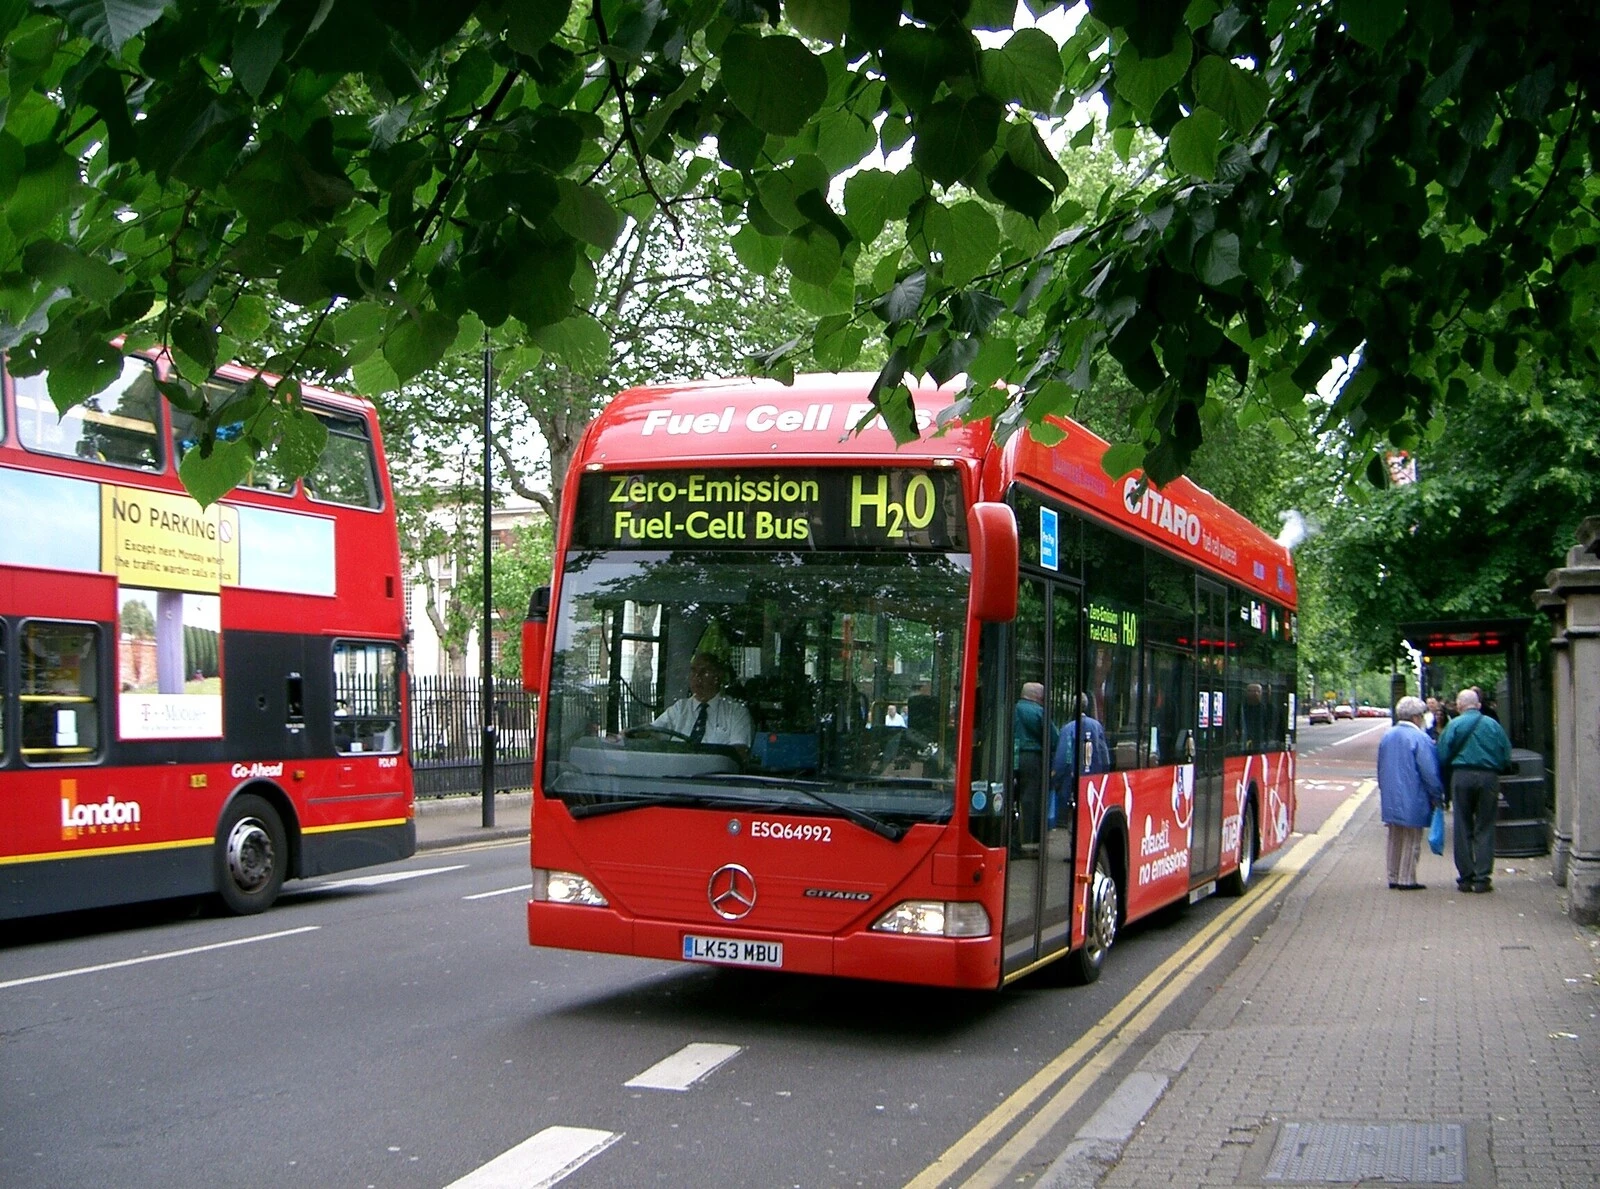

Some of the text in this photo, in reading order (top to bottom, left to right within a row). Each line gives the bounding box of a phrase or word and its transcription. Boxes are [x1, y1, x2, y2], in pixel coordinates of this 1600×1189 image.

[641, 402, 933, 436] Fuel Cell Bs
[608, 475, 819, 503] Zero-Emission
[112, 497, 216, 540] NO PARKING
[1123, 476, 1201, 546] CITARO
[614, 511, 809, 540] Fuel-Cell Bus
[124, 539, 224, 566] Except next Monday when
[114, 555, 129, 568] the
[133, 559, 161, 572] traffic
[163, 565, 190, 576] warden
[192, 568, 208, 578] calls
[210, 571, 217, 579] in
[231, 762, 284, 778] Go-Ahead
[61, 795, 141, 828] London
[751, 821, 832, 842] ESQ64992
[1139, 847, 1188, 886] no emissions
[805, 889, 870, 901] CITARO
[694, 939, 778, 963] LK53 MBU
